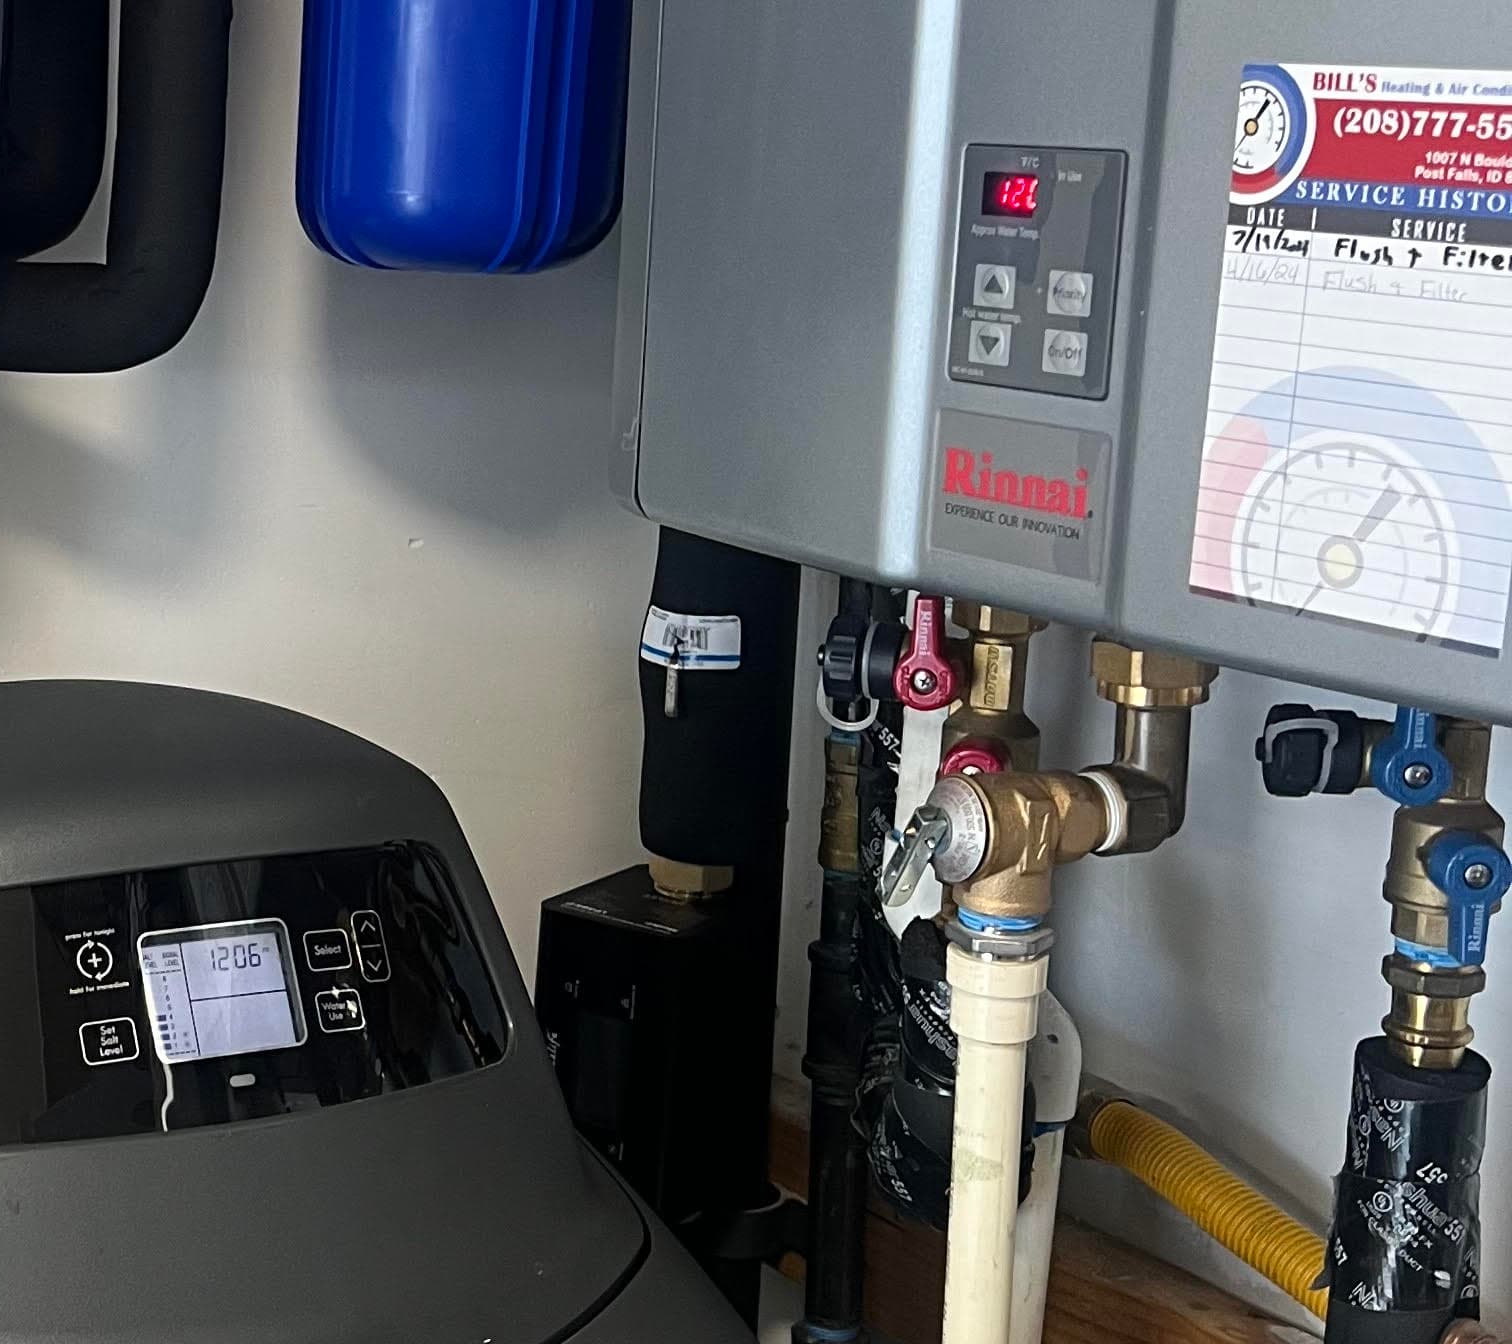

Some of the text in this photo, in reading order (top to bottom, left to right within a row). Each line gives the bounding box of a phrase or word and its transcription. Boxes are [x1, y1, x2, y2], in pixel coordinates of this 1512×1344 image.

[1312, 71, 1377, 93] BILL'S
[1381, 81, 1432, 96] Heating
[1434, 83, 1445, 95] &
[1448, 84, 1468, 96] Air
[1425, 150, 1457, 166] 1007
[1459, 152, 1471, 166] N
[1414, 164, 1444, 180] Post
[1446, 165, 1483, 185] Falls,
[1486, 170, 1501, 184] ID
[1295, 179, 1406, 206] SERVICE
[1246, 206, 1285, 227] DATE
[1391, 218, 1467, 243] SERVICE
[1047, 343, 1082, 360] On/Off
[943, 446, 1089, 521] Rinnai
[944, 502, 1080, 540] EXPERIENCE OUR INNOVATION
[920, 610, 932, 656] Rinnai
[878, 726, 901, 752] 557
[1467, 903, 1485, 954] Rinnai
[314, 944, 342, 956] Select
[321, 1001, 346, 1011] Water
[328, 1012, 344, 1021] Use
[99, 1025, 116, 1036] Set
[100, 1035, 119, 1046] Salt
[907, 998, 957, 1066] ashua
[99, 1044, 124, 1057] Level
